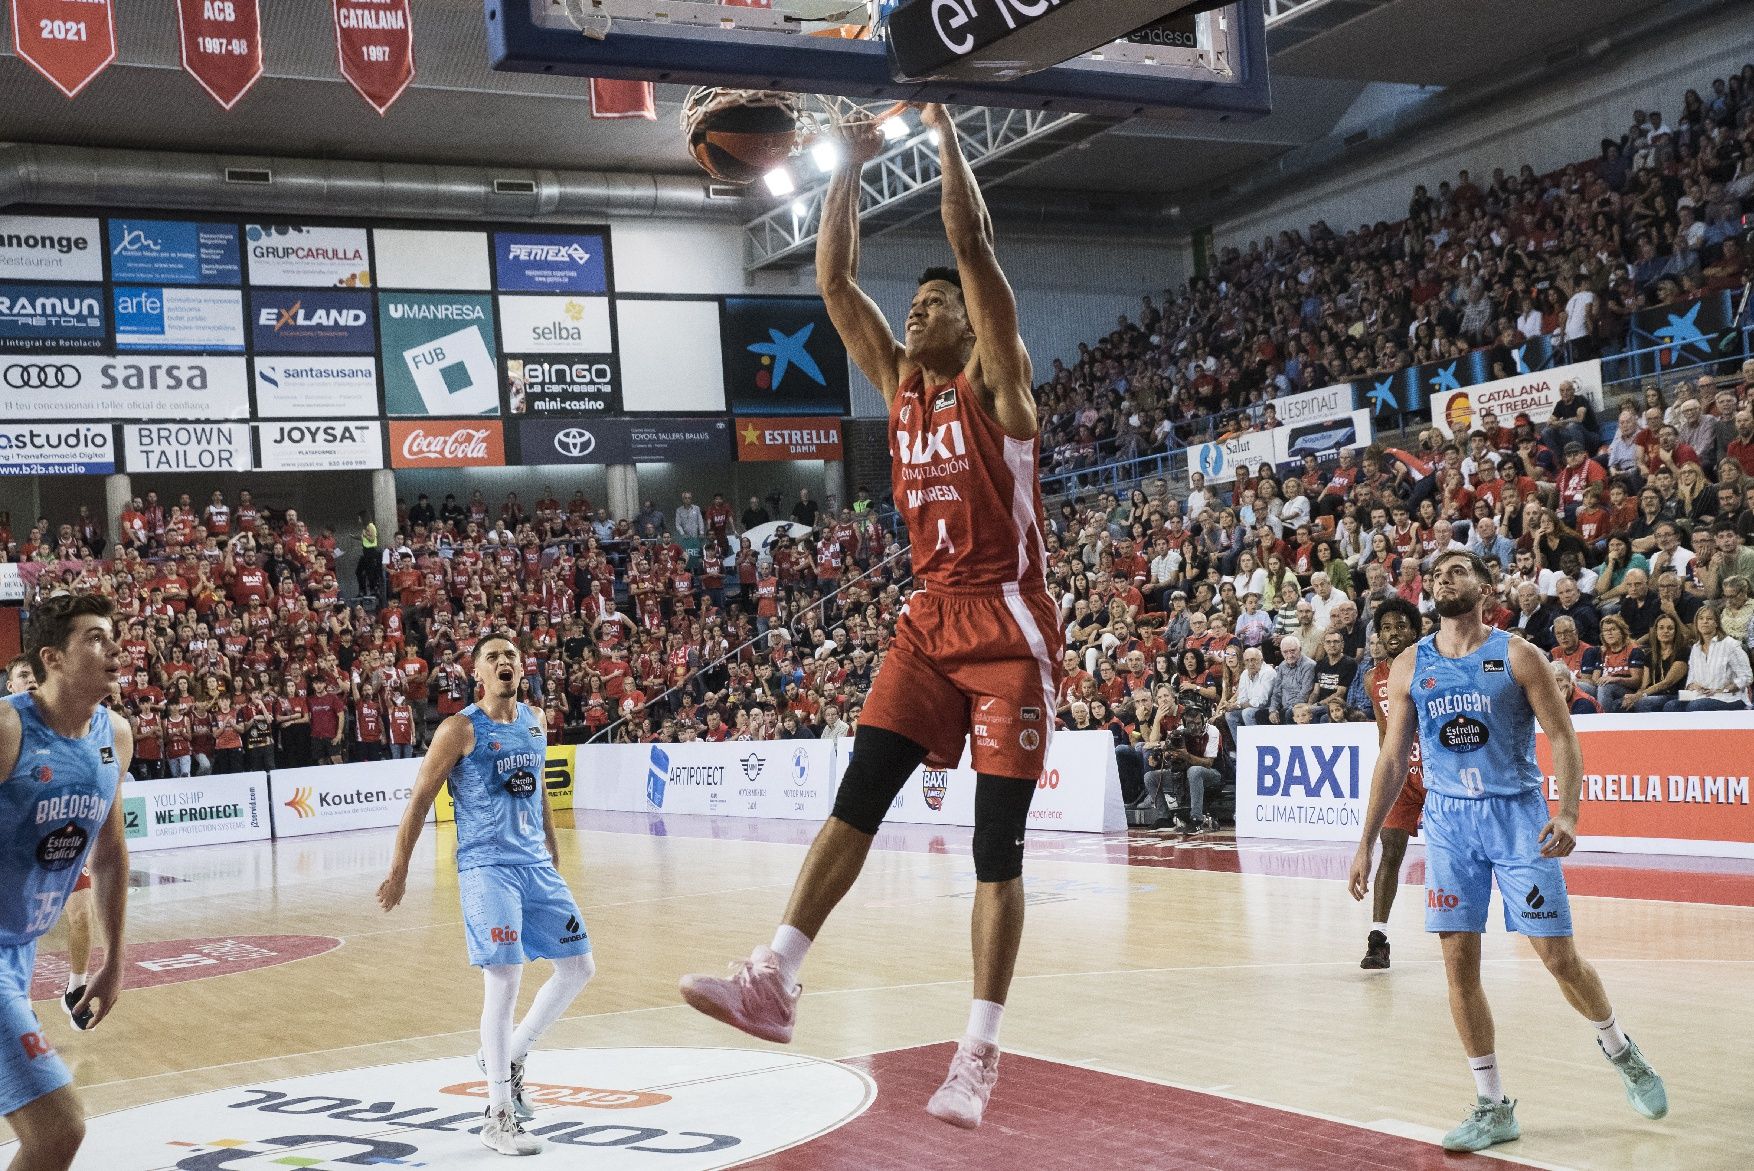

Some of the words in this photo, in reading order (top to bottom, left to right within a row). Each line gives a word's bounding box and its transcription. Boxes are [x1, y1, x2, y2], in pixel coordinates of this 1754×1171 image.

[204, 6, 236, 22] ACB
[340, 8, 405, 30] CATALANA
[40, 19, 87, 41] 2021
[197, 37, 248, 55] 1997-98
[362, 45, 390, 61] 1997
[253, 246, 362, 260] GRUPCARULLA
[509, 244, 570, 261] PENTEX
[119, 292, 160, 314] arfe
[388, 304, 484, 319] UMANRESA
[259, 300, 367, 331] EXLAND
[532, 321, 581, 340] selba
[413, 347, 446, 369] FUB
[101, 364, 208, 390] sarsa
[284, 367, 372, 378] santasusana
[525, 364, 611, 382] BINGO
[1477, 382, 1551, 404] CATALANA
[534, 399, 605, 410] mini-casino
[1500, 395, 1553, 414] TREBALL
[138, 427, 232, 445] BROWN
[764, 430, 839, 444] ESTRELLA
[790, 445, 817, 453] DAMM
[1226, 440, 1250, 454] Salut
[140, 449, 233, 468] TAILOR
[1446, 725, 1480, 735] Estrella
[1449, 734, 1480, 744] Galicia
[924, 771, 947, 787] BAXI
[1256, 745, 1360, 799] BAXI
[1459, 768, 1484, 797] 10
[1547, 775, 1662, 802] ETRELLA
[1667, 776, 1750, 804] DAMM
[154, 794, 176, 807] YOU
[180, 792, 204, 805] SHIP
[155, 810, 175, 824] WE
[180, 804, 239, 822] PROTECT
[1256, 803, 1360, 826] CLIMATIZACIÓN
